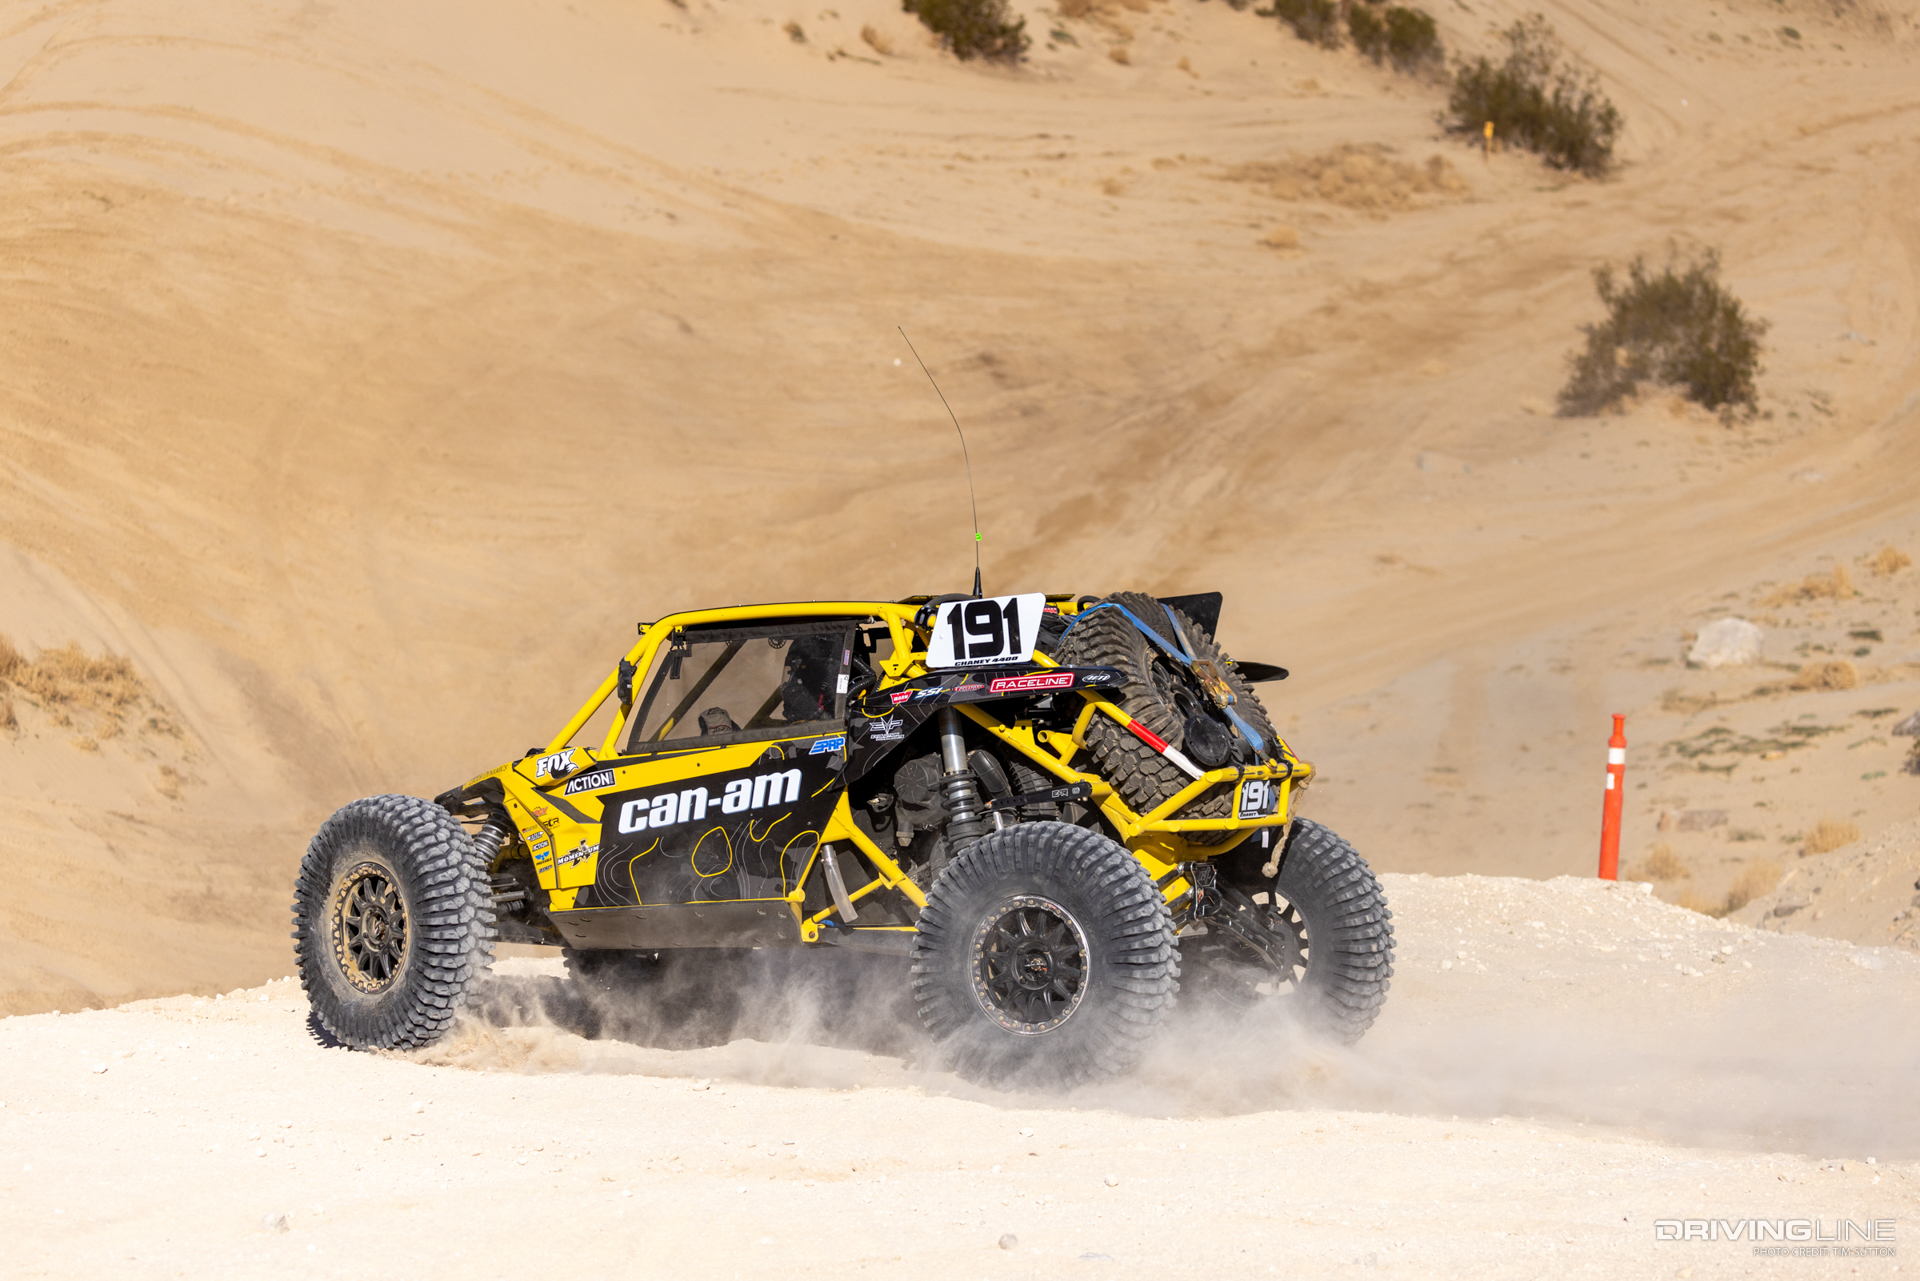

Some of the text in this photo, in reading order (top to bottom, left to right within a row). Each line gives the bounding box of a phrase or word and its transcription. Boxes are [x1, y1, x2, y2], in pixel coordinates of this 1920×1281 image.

[947, 597, 1022, 660] 191
[954, 655, 1019, 666] CHANEY 4400
[994, 676, 1069, 690] RACELINE
[809, 736, 845, 755] PRP
[535, 747, 580, 780] FOX
[566, 771, 610, 795] ACTION
[1241, 779, 1271, 811] 191
[617, 767, 803, 835] can-am
[557, 844, 600, 865] MOMENUM
